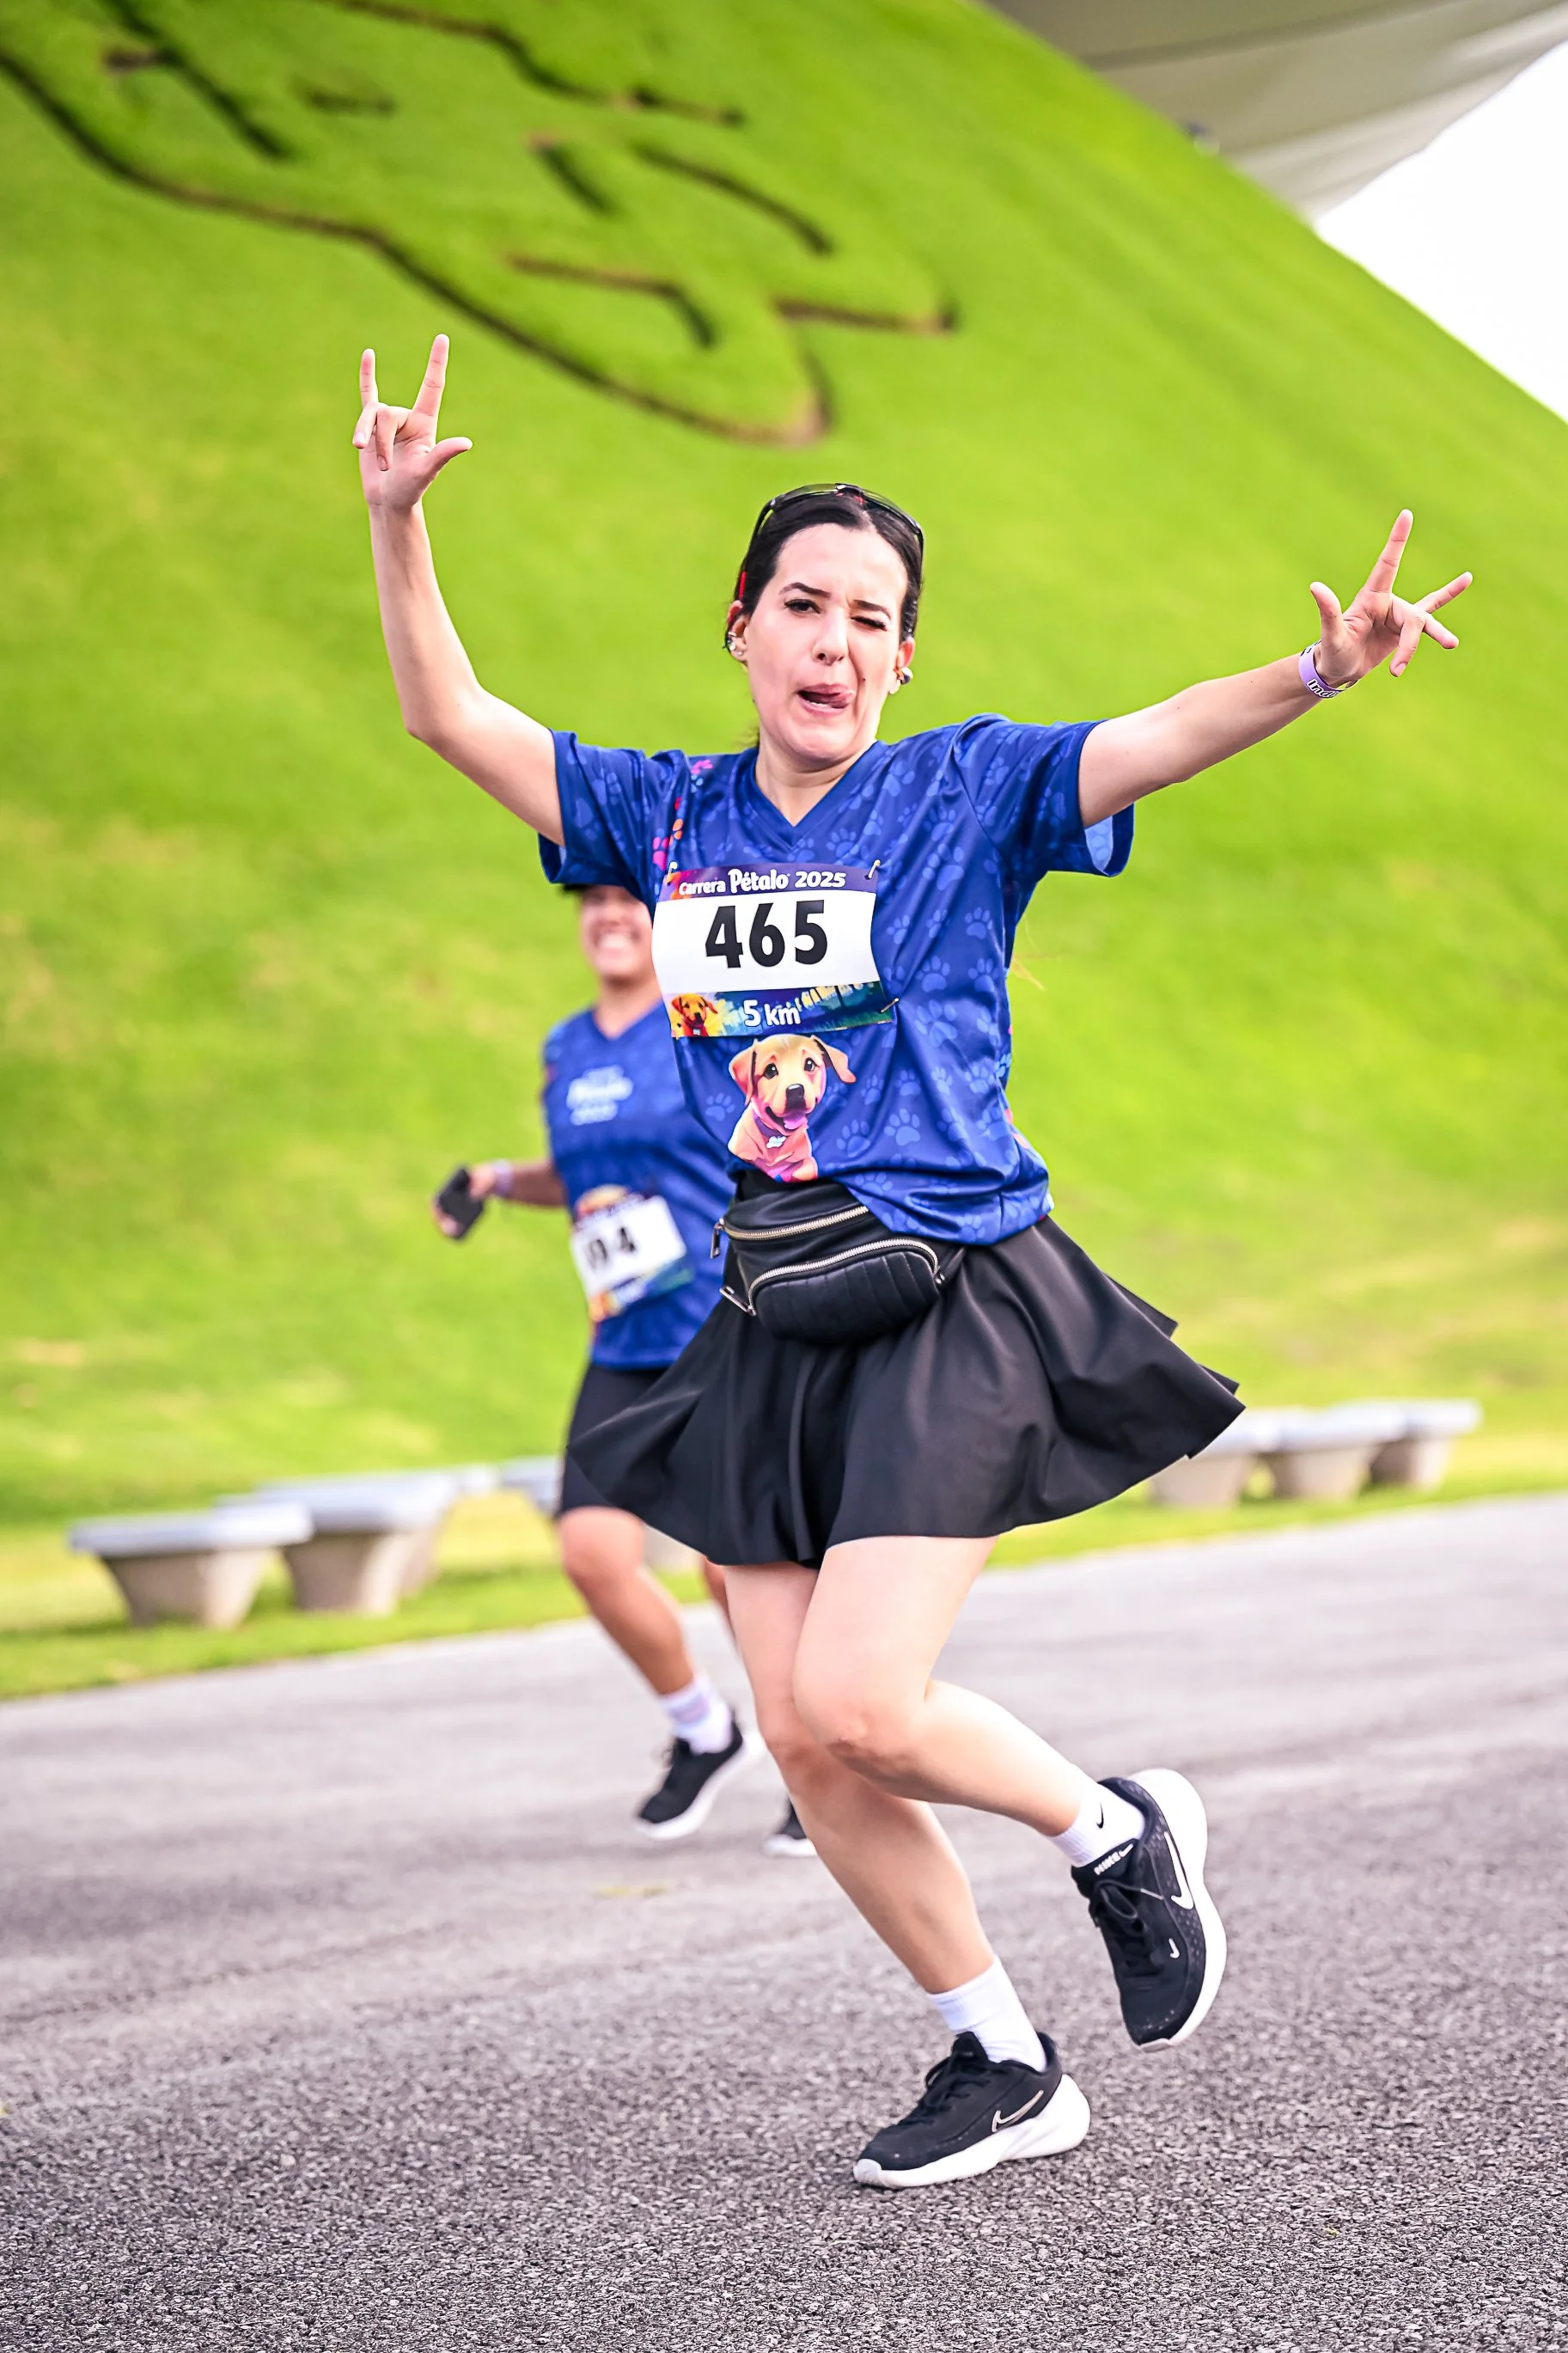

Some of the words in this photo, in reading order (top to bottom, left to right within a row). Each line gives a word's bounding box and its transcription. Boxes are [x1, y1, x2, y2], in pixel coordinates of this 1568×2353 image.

[728, 869, 789, 893] Pétalo
[795, 871, 846, 888] 2025
[705, 899, 827, 969] 465
[742, 999, 760, 1027] 5
[764, 1004, 801, 1025] km
